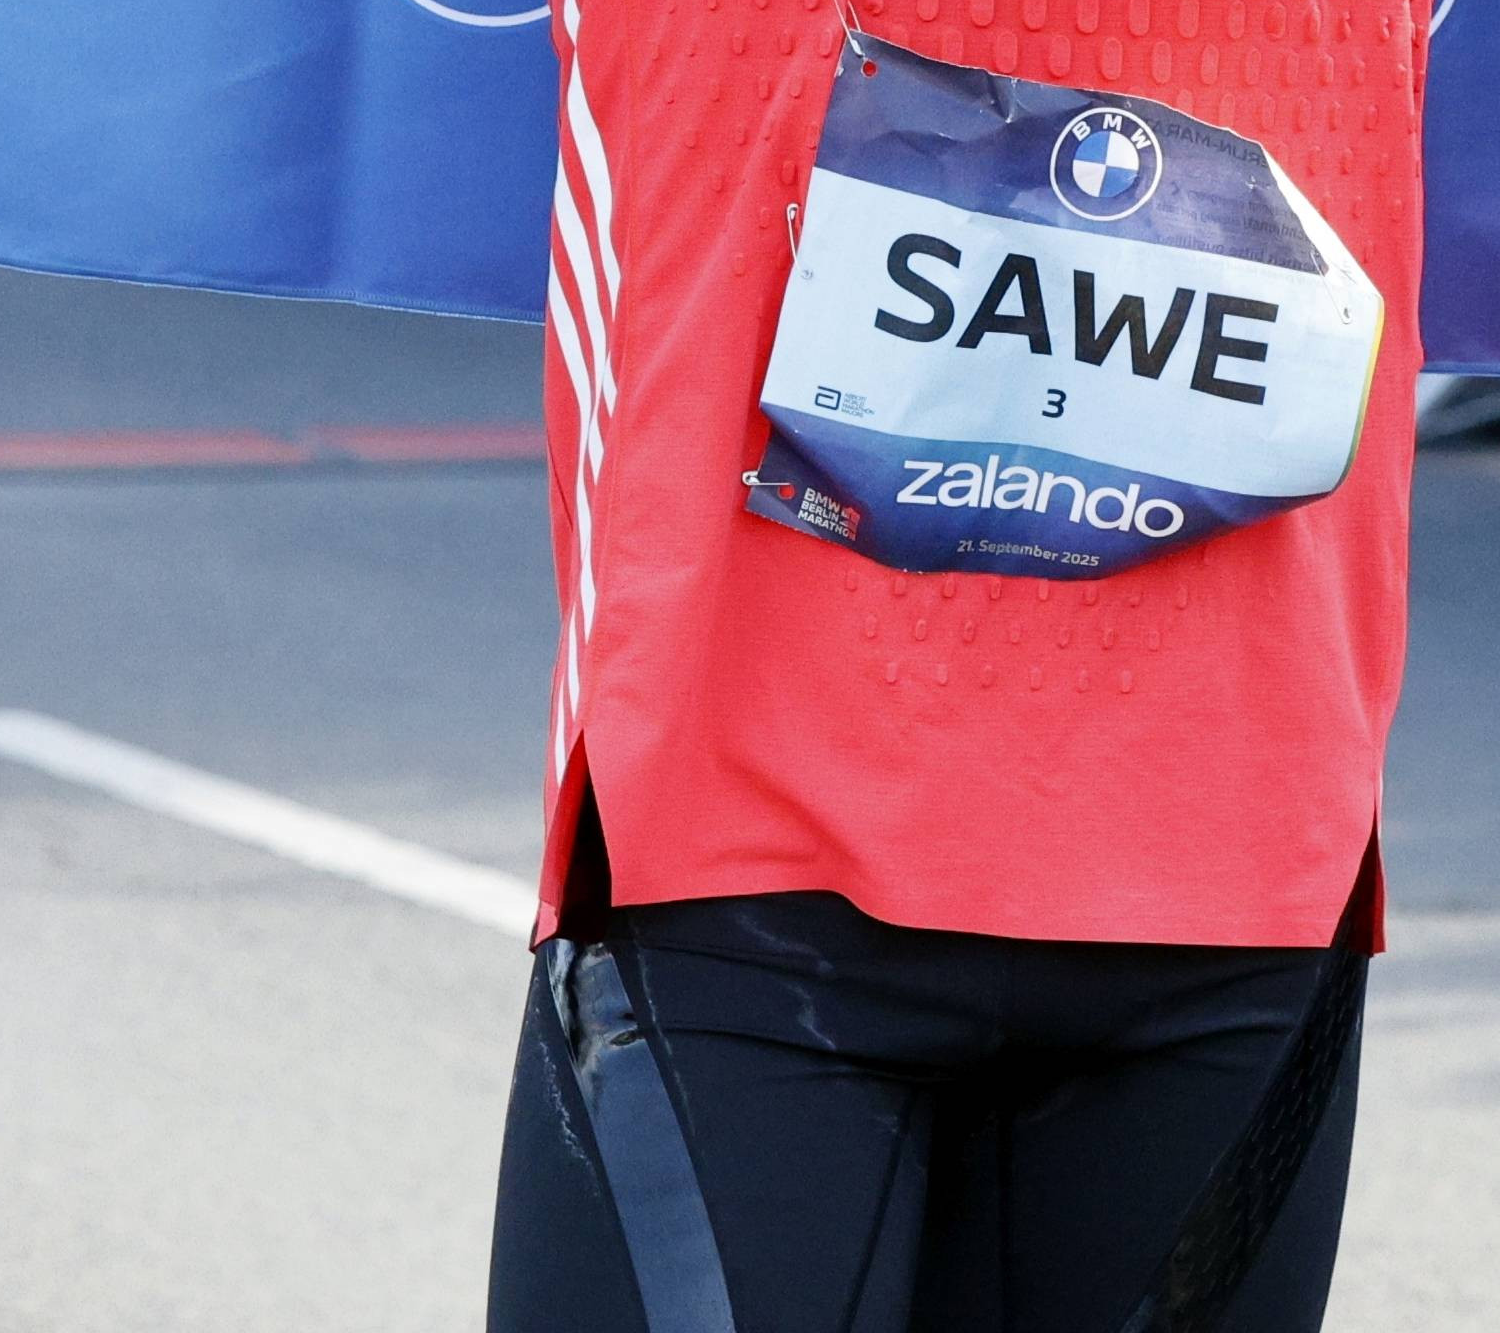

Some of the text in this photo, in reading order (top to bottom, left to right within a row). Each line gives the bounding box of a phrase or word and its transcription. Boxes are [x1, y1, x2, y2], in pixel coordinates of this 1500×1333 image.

[1071, 113, 1151, 150] BMW
[873, 232, 1281, 406] SAWE
[1041, 388, 1067, 418] 3
[801, 500, 840, 523] BERLIN
[803, 487, 841, 513] BMW
[896, 457, 1185, 537] zalando
[797, 509, 856, 541] MARATHON
[957, 539, 1100, 566] 21. September 2025
